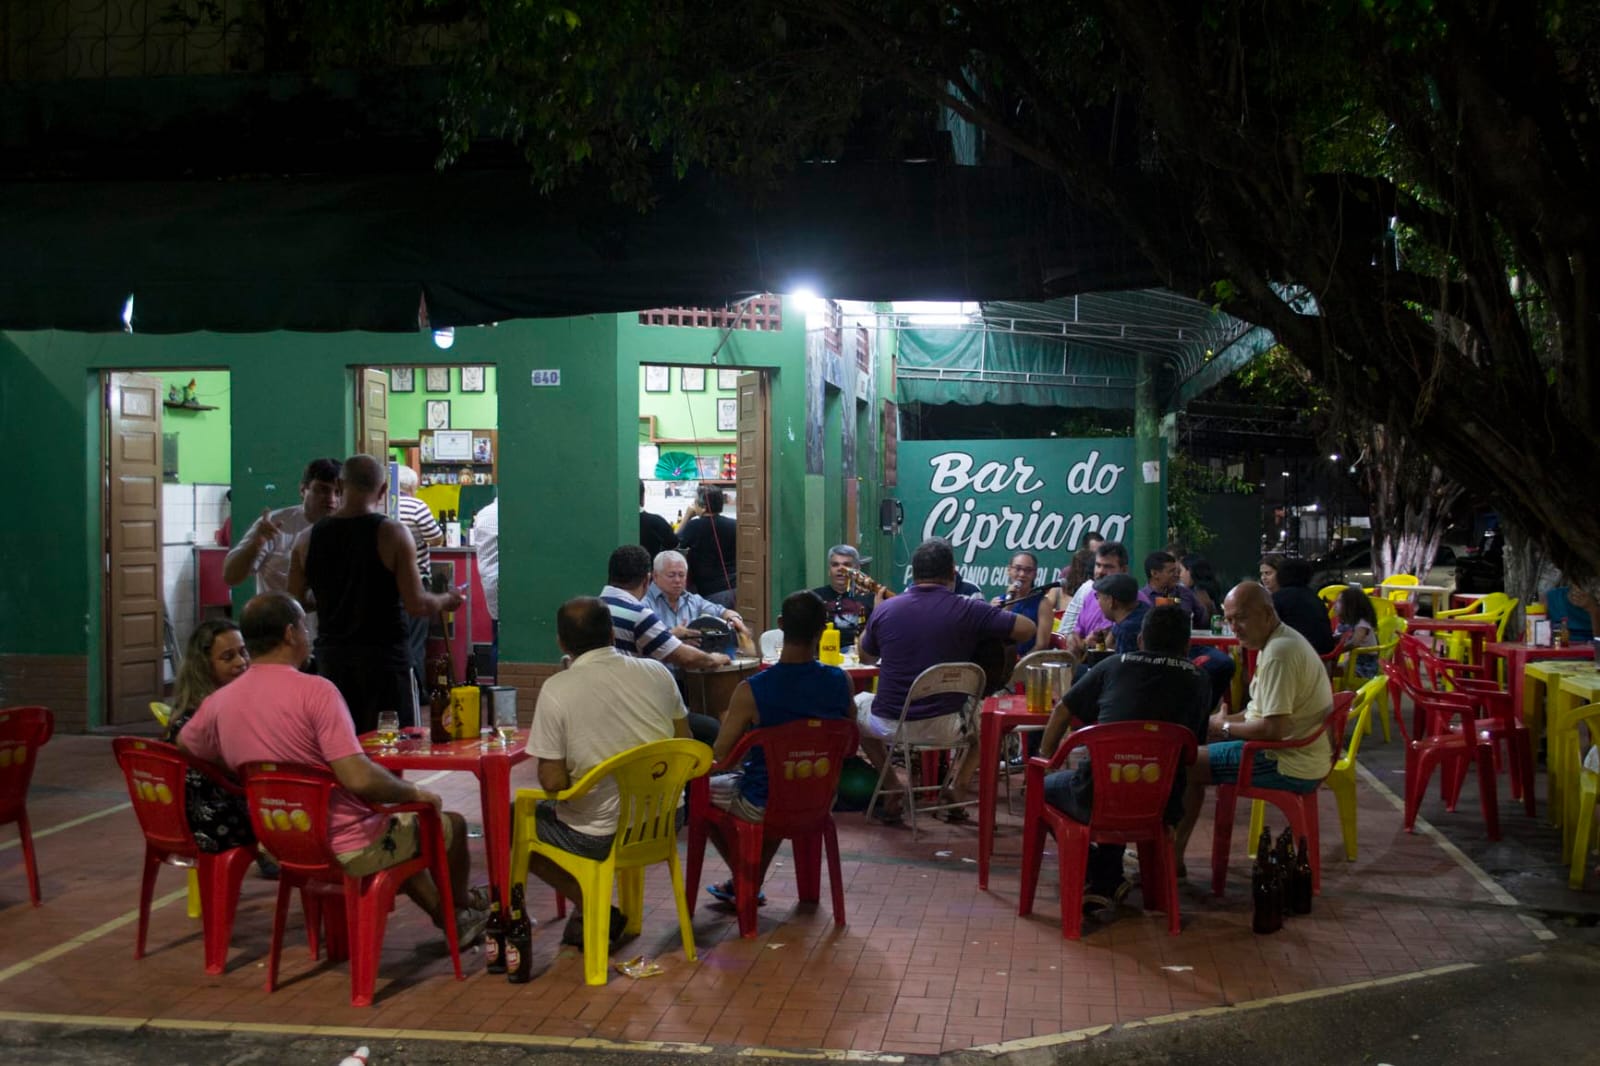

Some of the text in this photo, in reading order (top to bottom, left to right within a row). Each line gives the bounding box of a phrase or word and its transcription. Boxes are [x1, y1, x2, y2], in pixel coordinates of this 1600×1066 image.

[930, 450, 1125, 494] Bar do
[922, 496, 1132, 563] Cipriano
